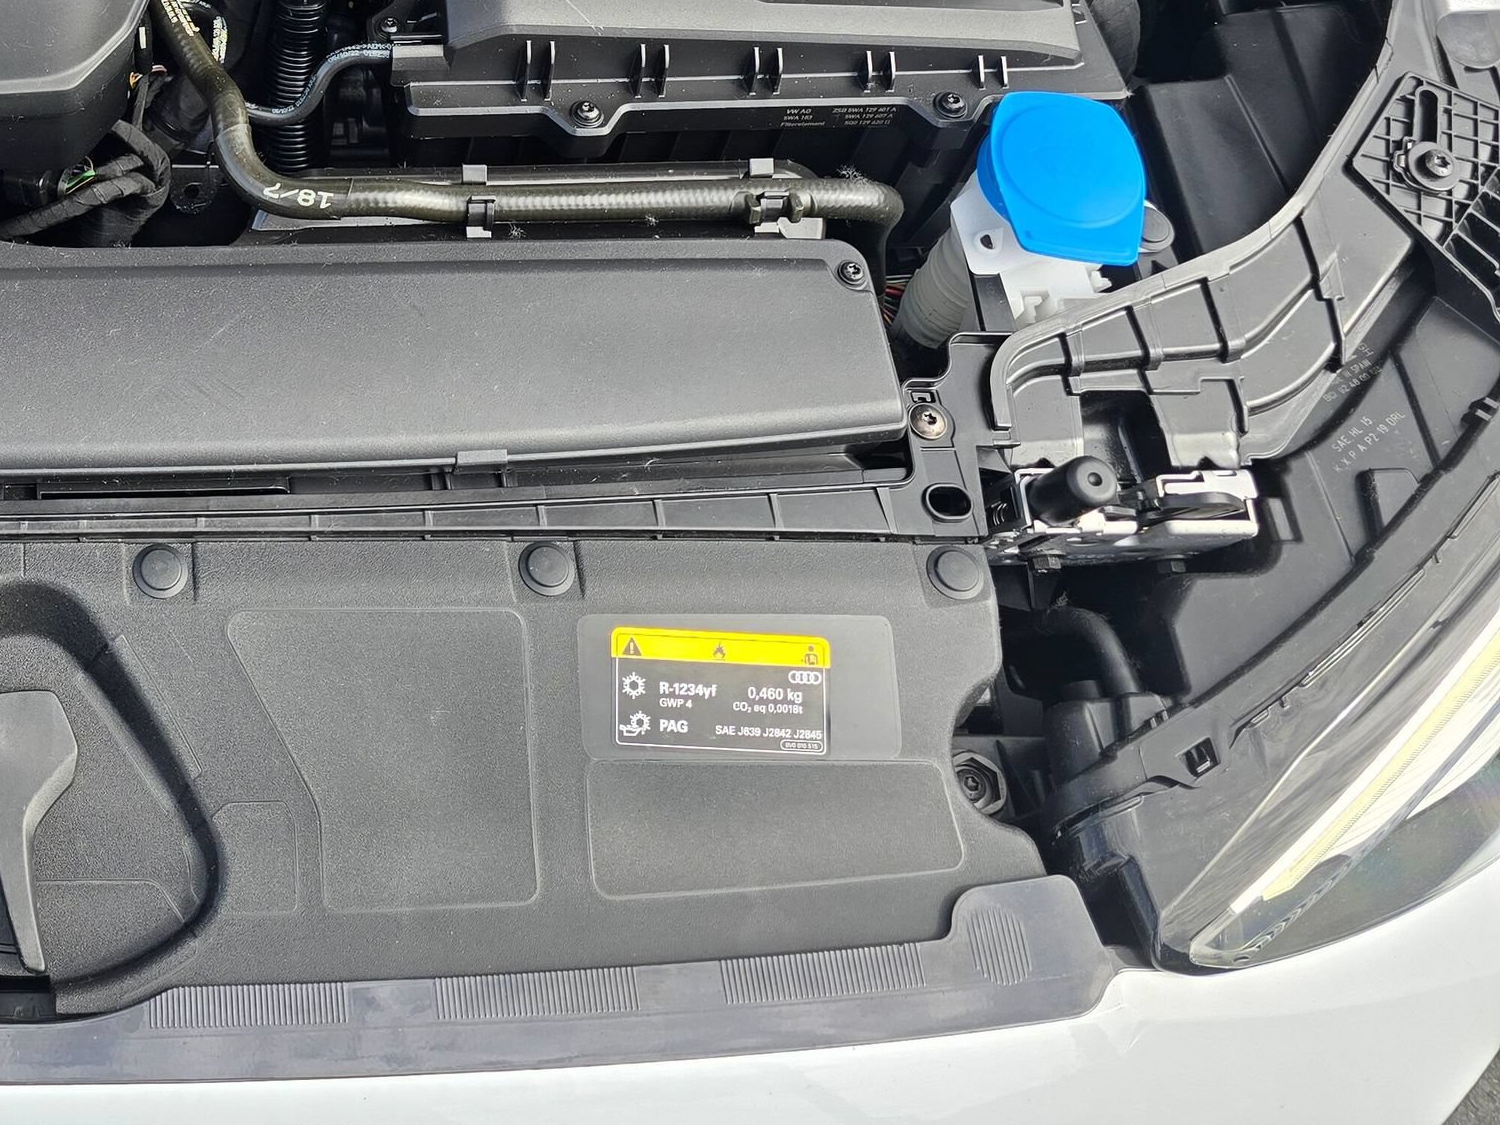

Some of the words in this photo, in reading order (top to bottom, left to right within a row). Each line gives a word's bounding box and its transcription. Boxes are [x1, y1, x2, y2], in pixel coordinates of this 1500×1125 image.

[1332, 435, 1351, 452] SAE
[1348, 427, 1363, 437] HL
[1361, 416, 1373, 426] 15
[1357, 443, 1367, 453] A
[1364, 433, 1380, 445] P2
[1377, 425, 1388, 434] 19
[1386, 411, 1405, 427] DRL
[659, 682, 717, 699] R-1234yf
[748, 687, 783, 701] 0,460
[787, 688, 803, 703] kg
[659, 699, 684, 707] GWP
[686, 699, 692, 708] 4
[754, 705, 766, 714] eq
[768, 704, 803, 715] 0,0018t
[659, 719, 688, 733] PAG
[715, 725, 736, 735] SAE
[738, 727, 761, 736] J639
[763, 727, 792, 738] J2842
[794, 729, 822, 740] J2845
